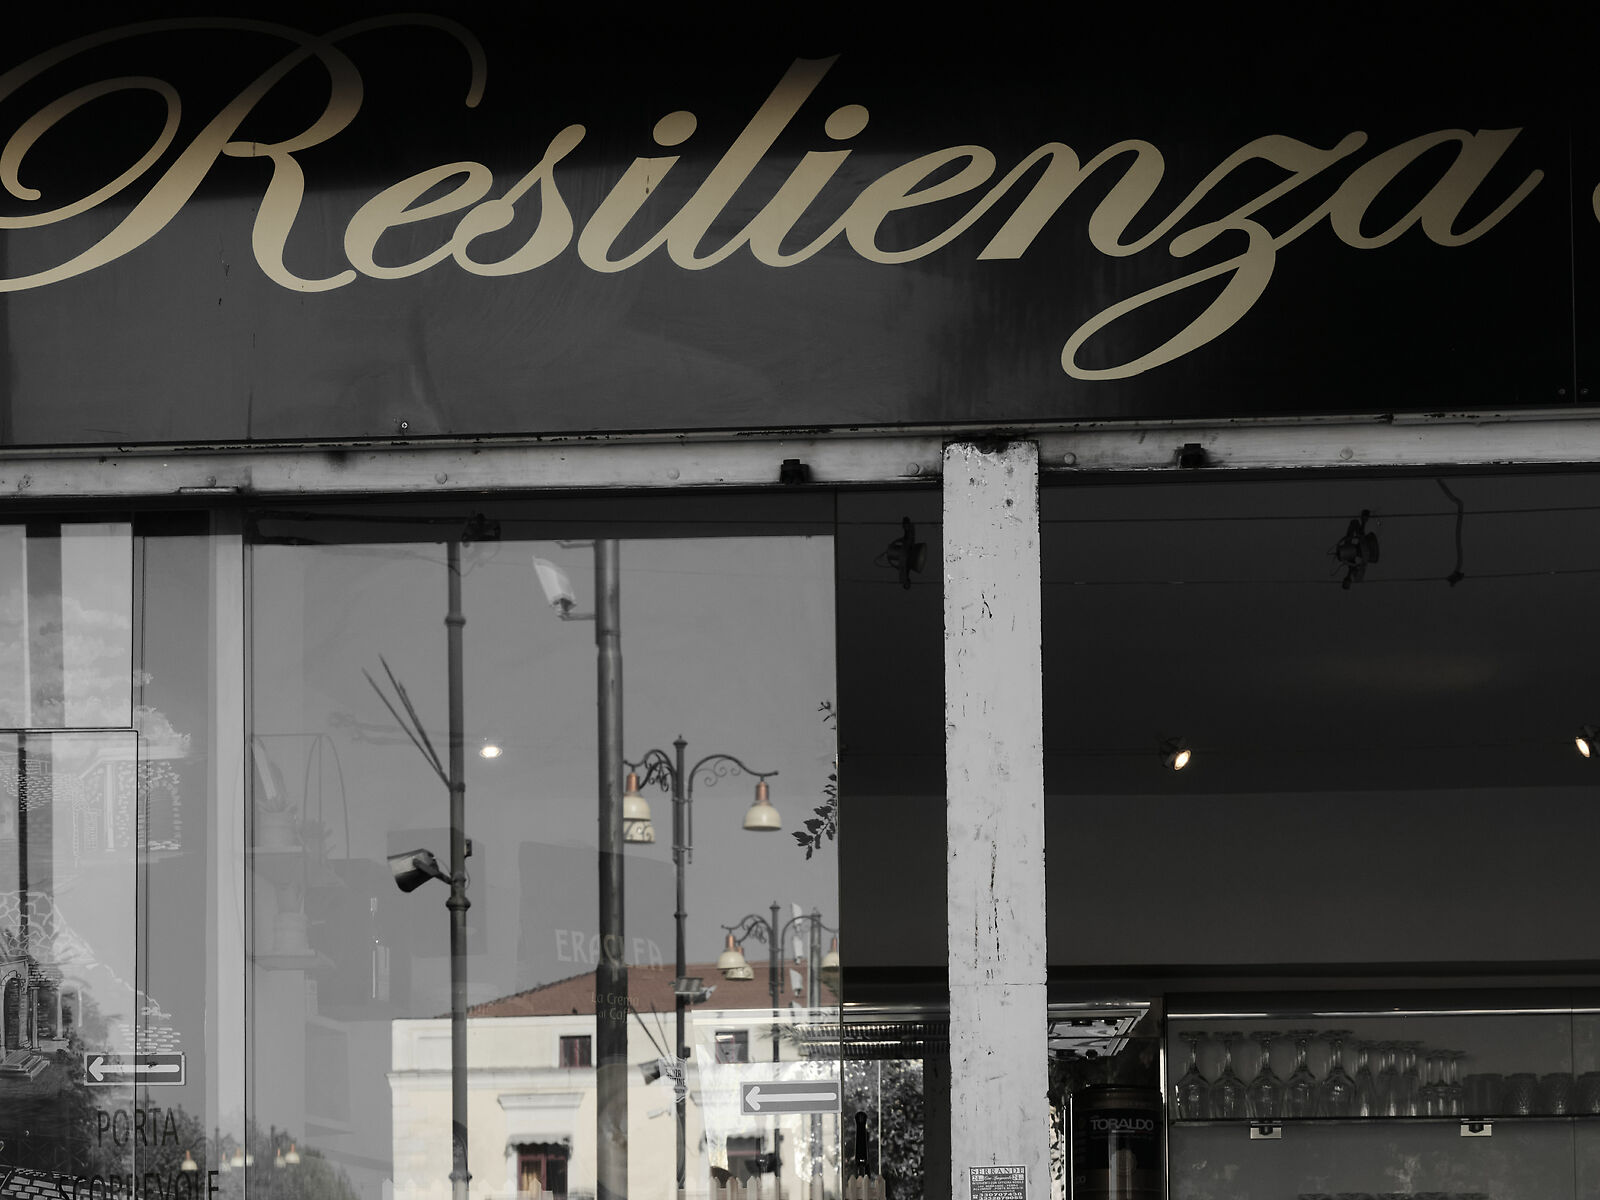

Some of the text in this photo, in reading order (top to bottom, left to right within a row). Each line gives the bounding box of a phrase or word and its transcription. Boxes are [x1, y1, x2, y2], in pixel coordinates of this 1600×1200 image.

[0, 11, 1544, 381] Resilienza
[97, 1107, 180, 1149] PORTA
[1090, 1118, 1154, 1131] TORALDO
